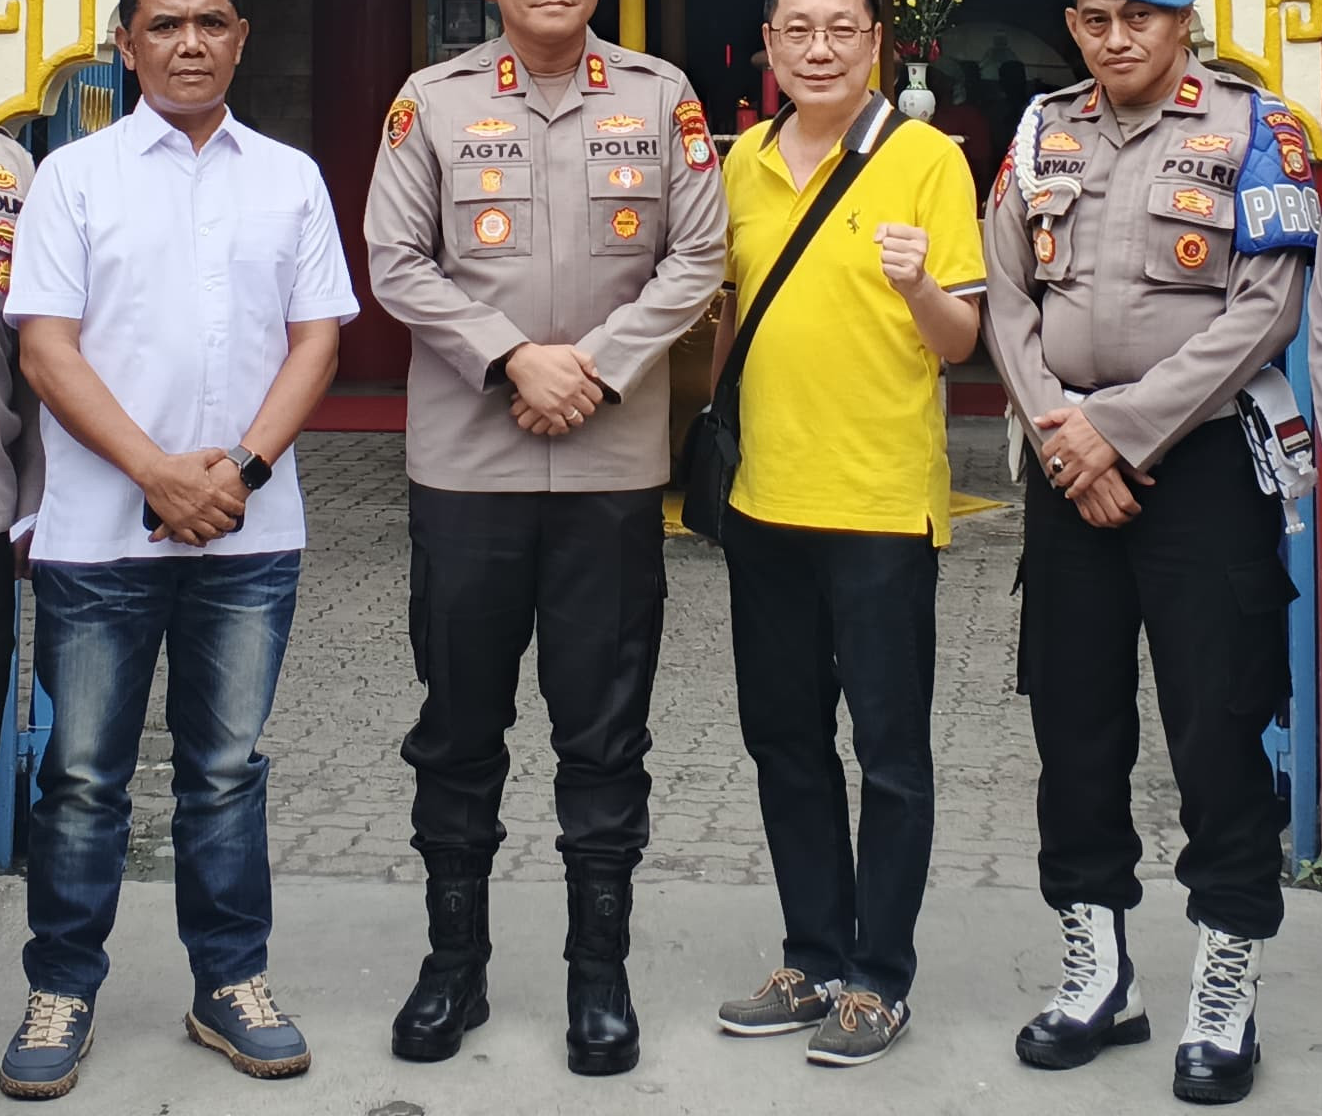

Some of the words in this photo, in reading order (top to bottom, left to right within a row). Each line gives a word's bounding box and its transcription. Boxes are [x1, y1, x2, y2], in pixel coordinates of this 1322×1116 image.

[460, 142, 523, 159] AGTA
[589, 139, 657, 157] POLRI
[1162, 159, 1235, 184] POLRI
